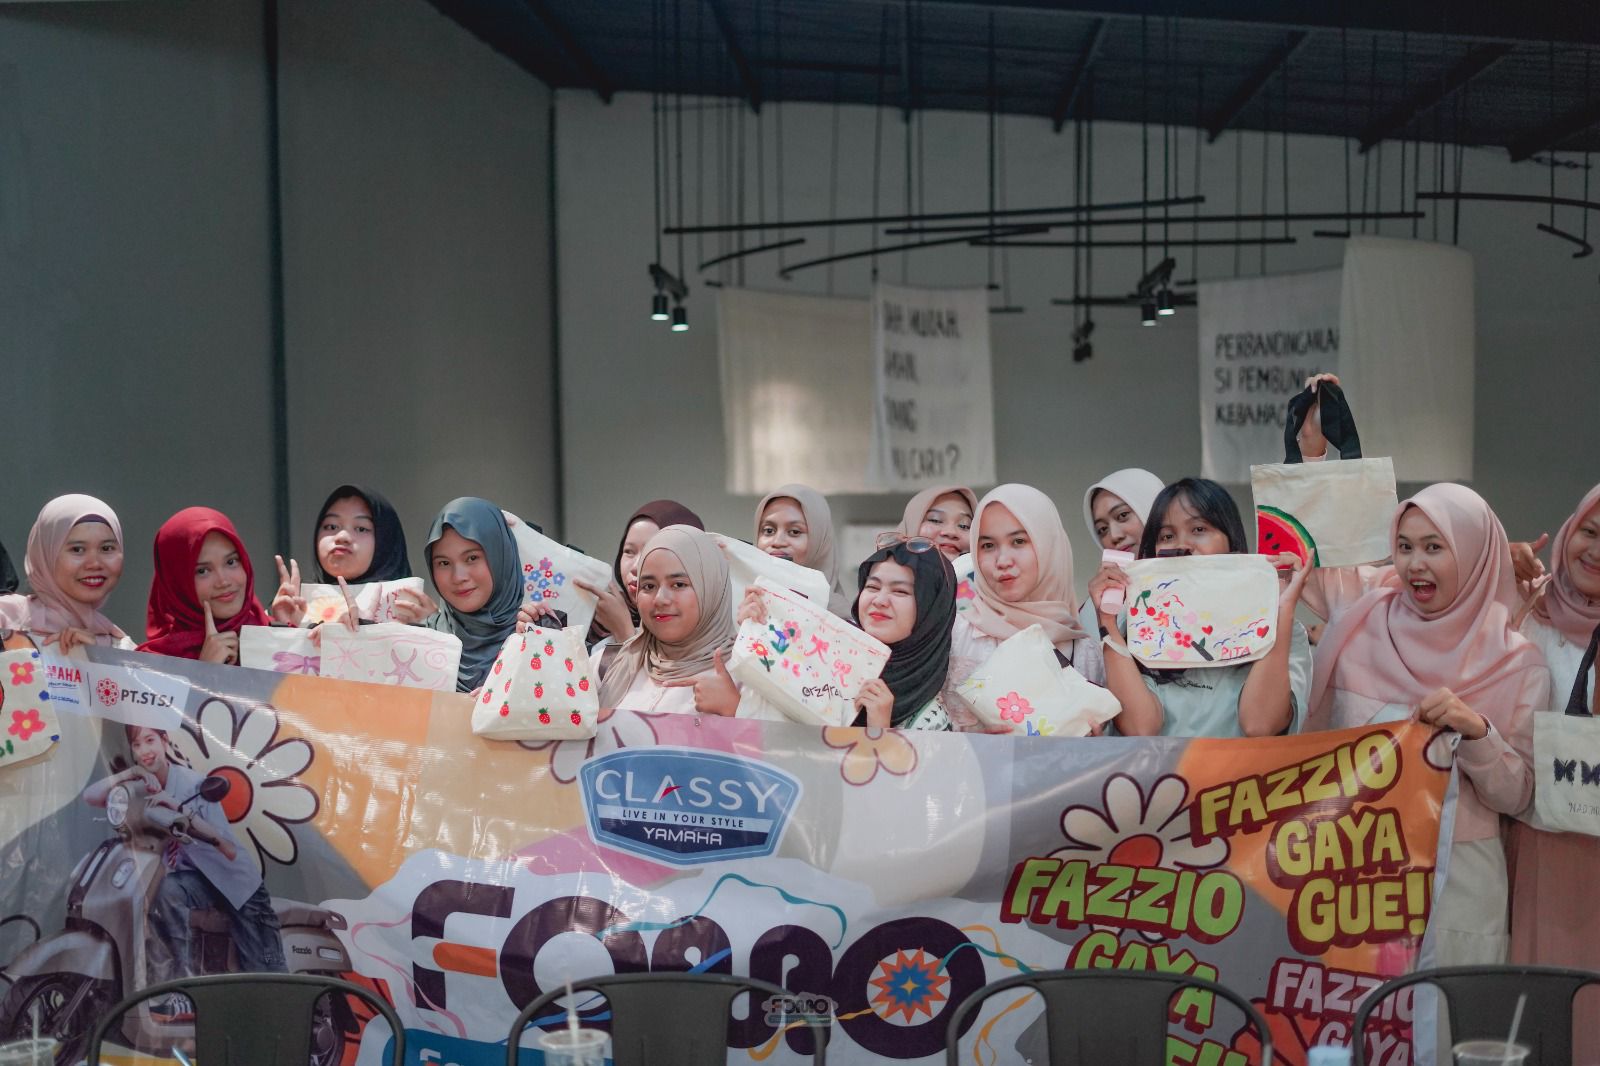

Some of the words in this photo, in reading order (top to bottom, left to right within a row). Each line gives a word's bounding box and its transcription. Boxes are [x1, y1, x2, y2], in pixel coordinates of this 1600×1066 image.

[1220, 645, 1251, 658] PITA
[120, 688, 174, 708] PT.STSJ
[595, 769, 781, 813] CLASSY
[1198, 732, 1399, 837] FAZZIO
[622, 809, 653, 820] LIVE
[653, 811, 666, 821] IN
[673, 814, 705, 825] YOUR
[711, 816, 744, 828] STYLE
[643, 826, 722, 846] YAMAHA
[1274, 810, 1406, 878] GAYA
[1009, 858, 1244, 938] FAZZIO
[1298, 870, 1433, 943] GUE!
